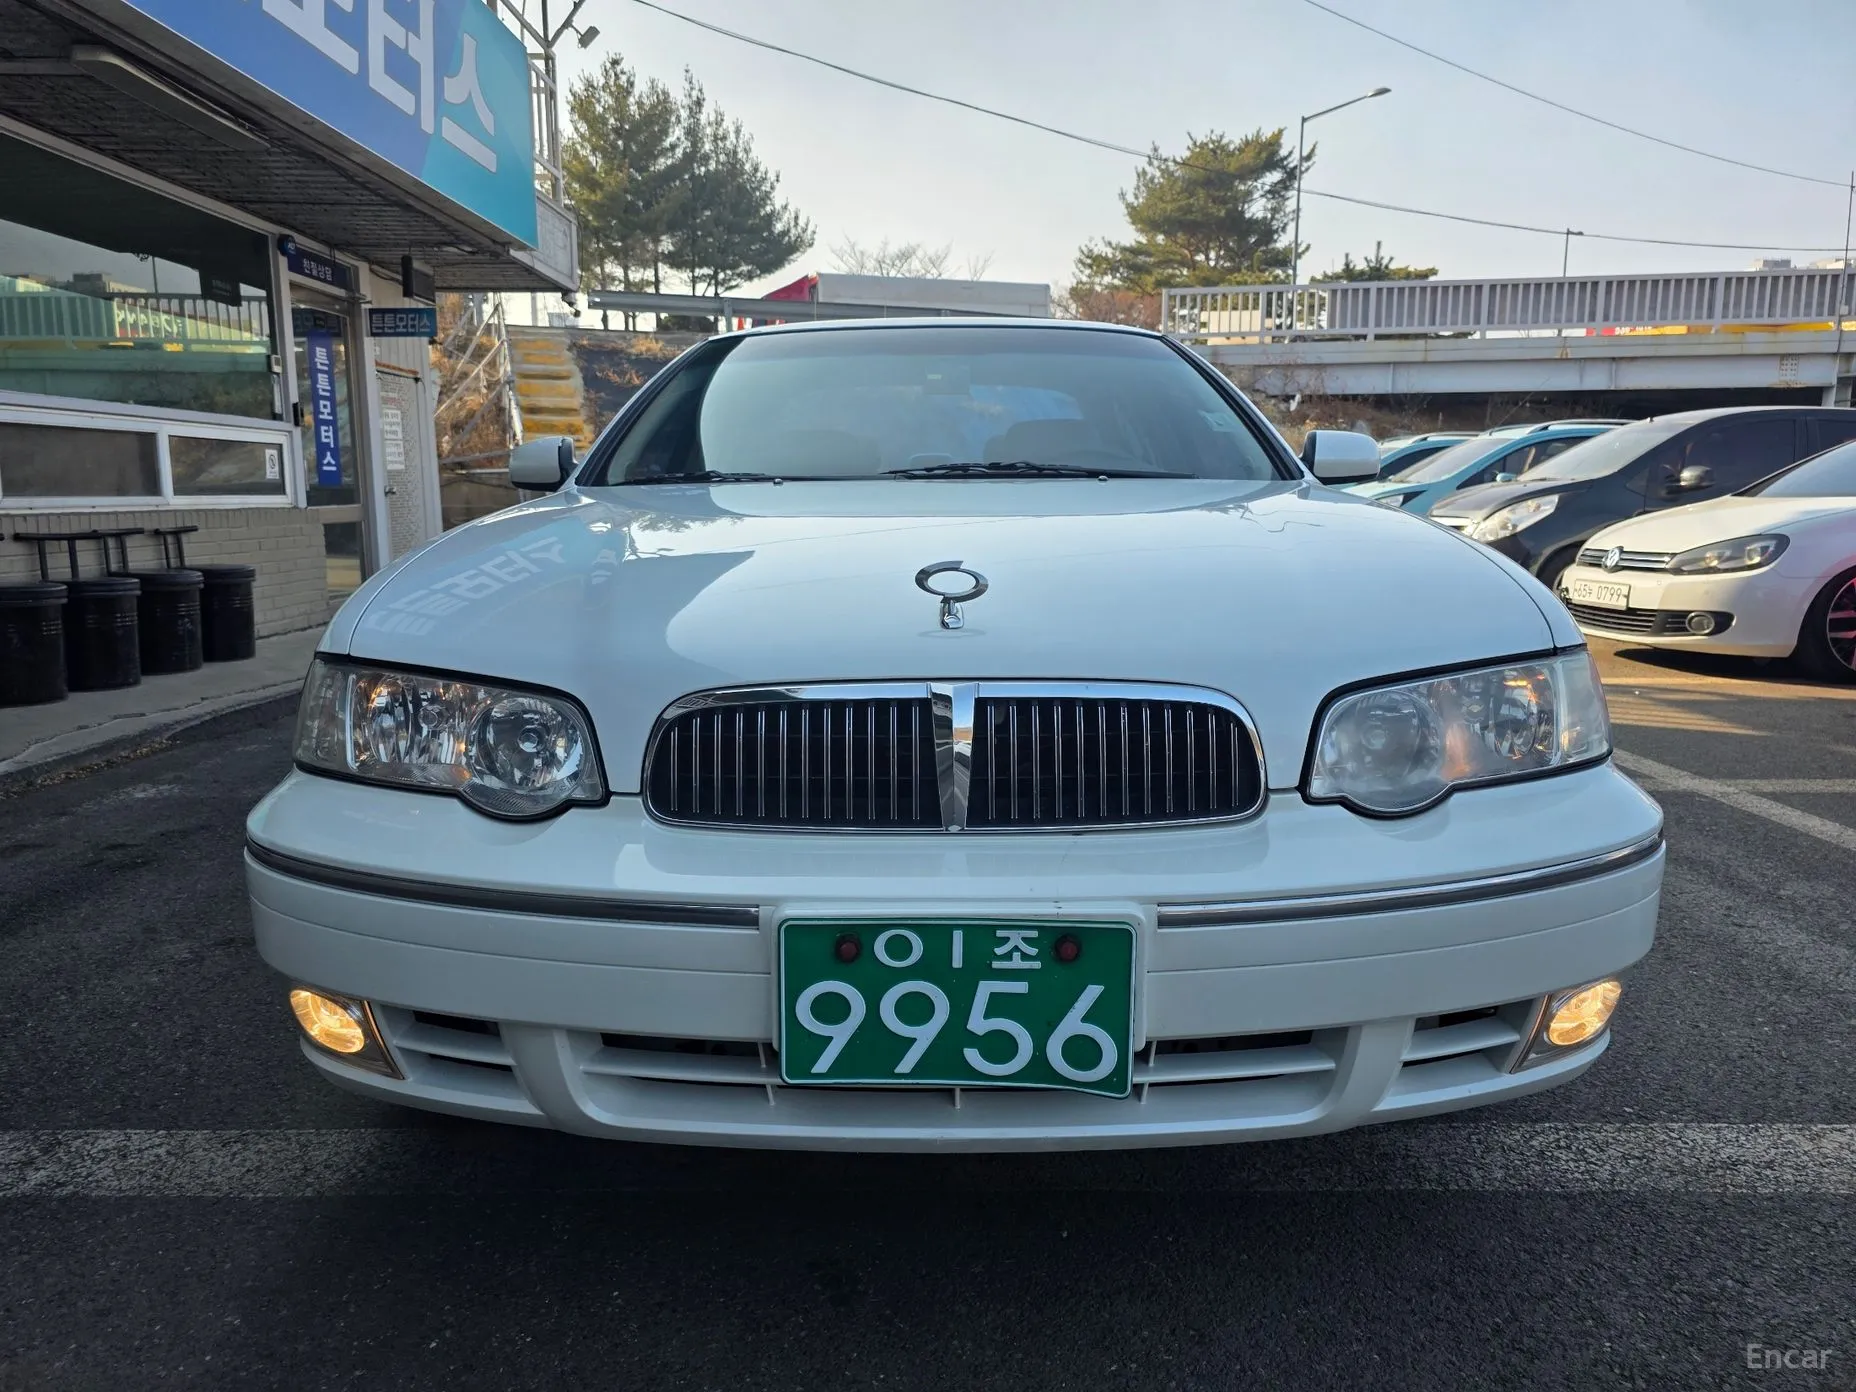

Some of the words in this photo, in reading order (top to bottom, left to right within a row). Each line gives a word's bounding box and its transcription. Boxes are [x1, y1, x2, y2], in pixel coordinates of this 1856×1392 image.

[372, 312, 431, 333] 튼튼모터스
[315, 346, 337, 471] 튼튼모터스
[1597, 585, 1622, 602] 0799
[795, 980, 1118, 1082] 9956
